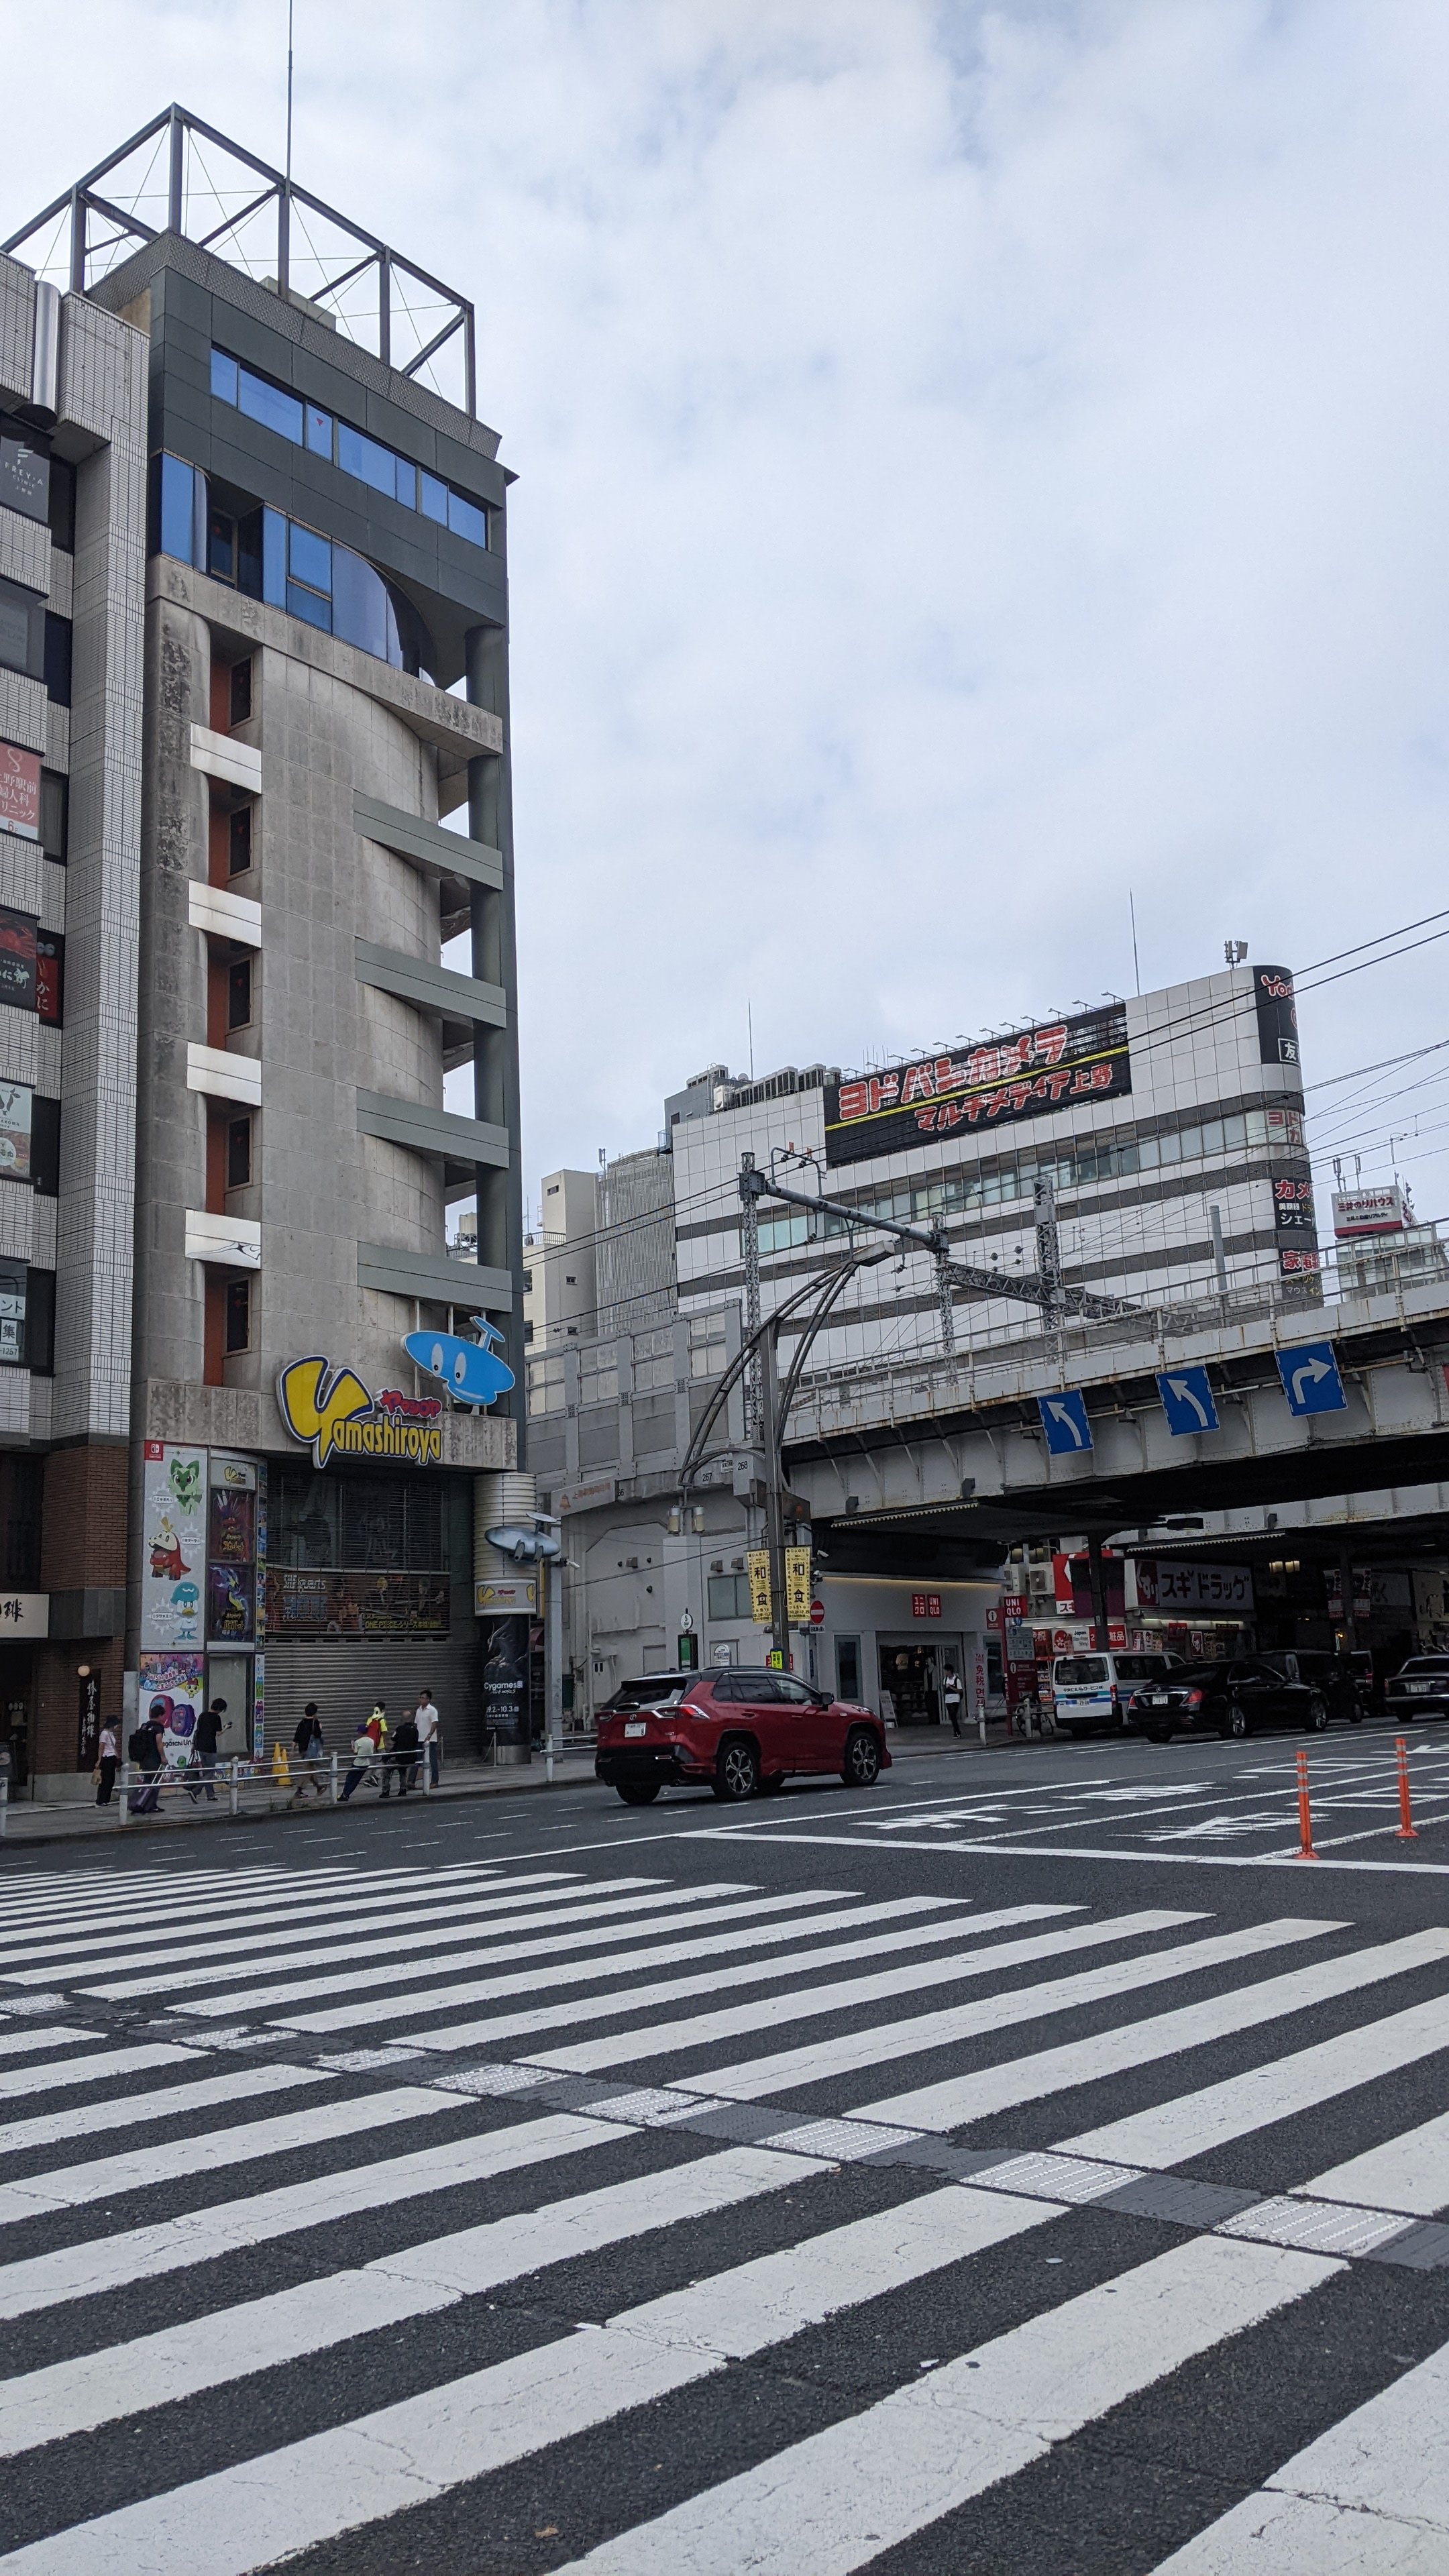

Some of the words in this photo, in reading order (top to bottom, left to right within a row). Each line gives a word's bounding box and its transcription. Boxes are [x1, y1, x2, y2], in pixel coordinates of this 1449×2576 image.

[36, 981, 50, 1011] かに
[839, 1025, 1068, 1120] ヨドバシカメラ
[914, 1063, 1113, 1131] マルチメディア上野
[1338, 1196, 1394, 1212] 三井のリハウス
[3, 1324, 15, 1338] 集
[279, 1355, 443, 1469] Yamashiroya
[702, 1472, 712, 1482] 267
[1161, 1570, 1249, 1601] スギドラッグ
[929, 1597, 939, 1605] UNI
[1006, 1599, 1020, 1607] UNI
[930, 1606, 940, 1615] QLO
[1007, 1607, 1021, 1617] QLO
